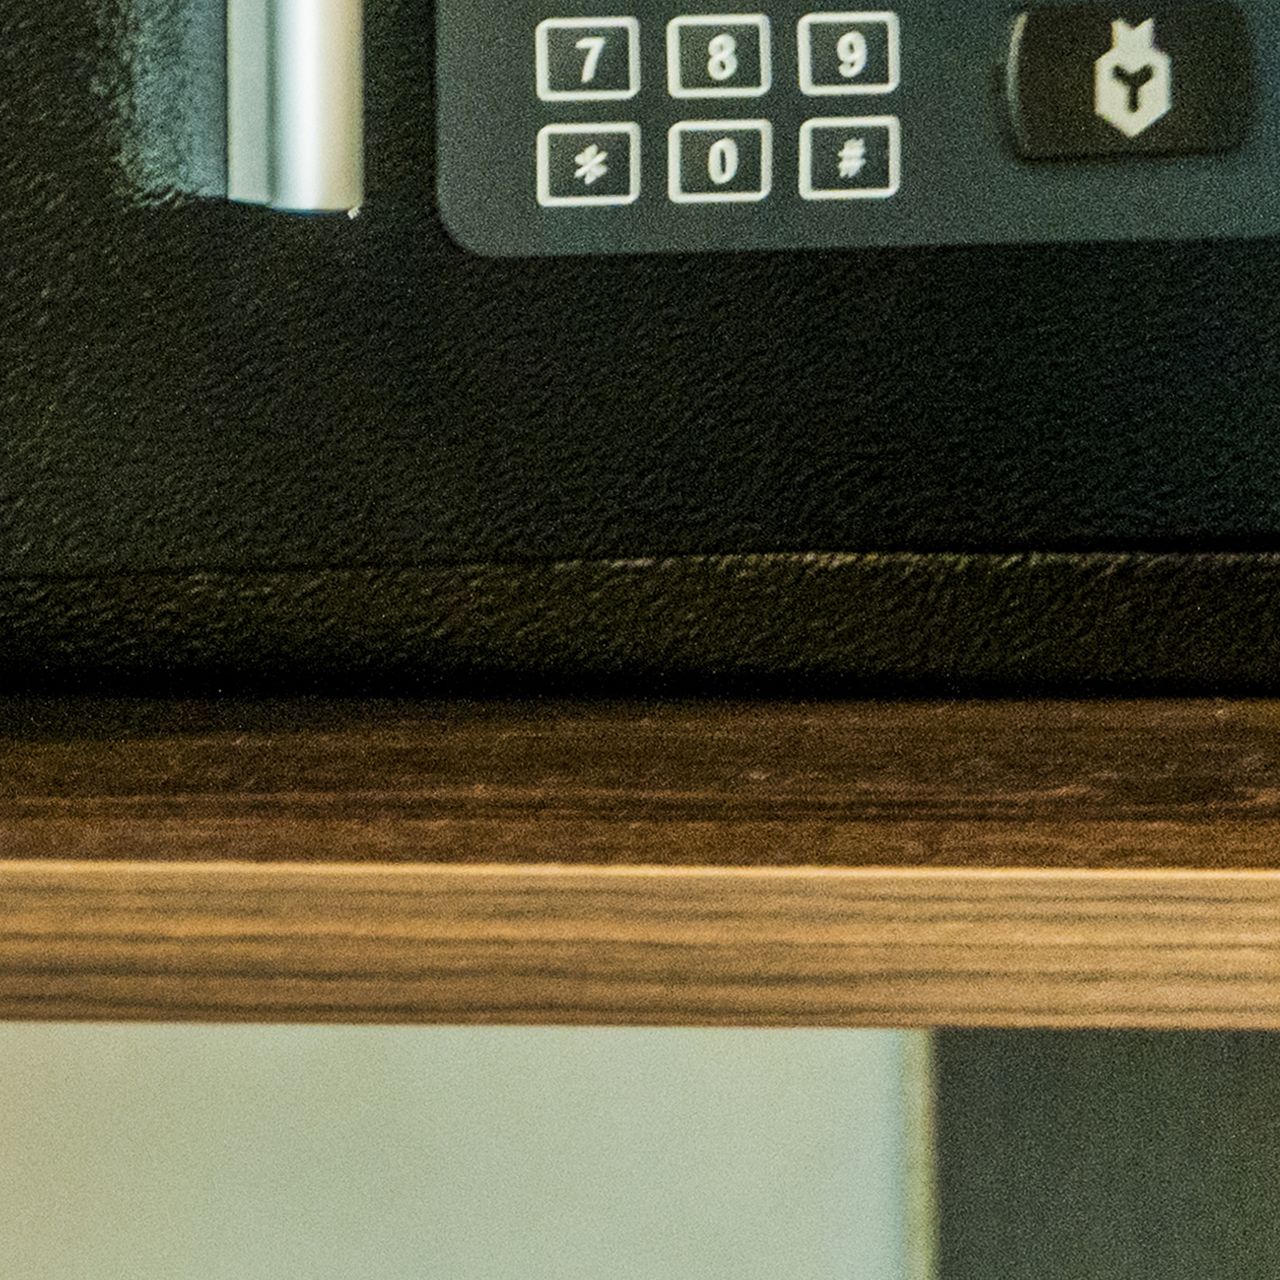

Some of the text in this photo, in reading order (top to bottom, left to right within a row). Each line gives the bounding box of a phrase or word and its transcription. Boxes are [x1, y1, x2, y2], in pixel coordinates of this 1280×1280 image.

[575, 30, 867, 83] 7 8 9
[708, 137, 739, 184] 0
